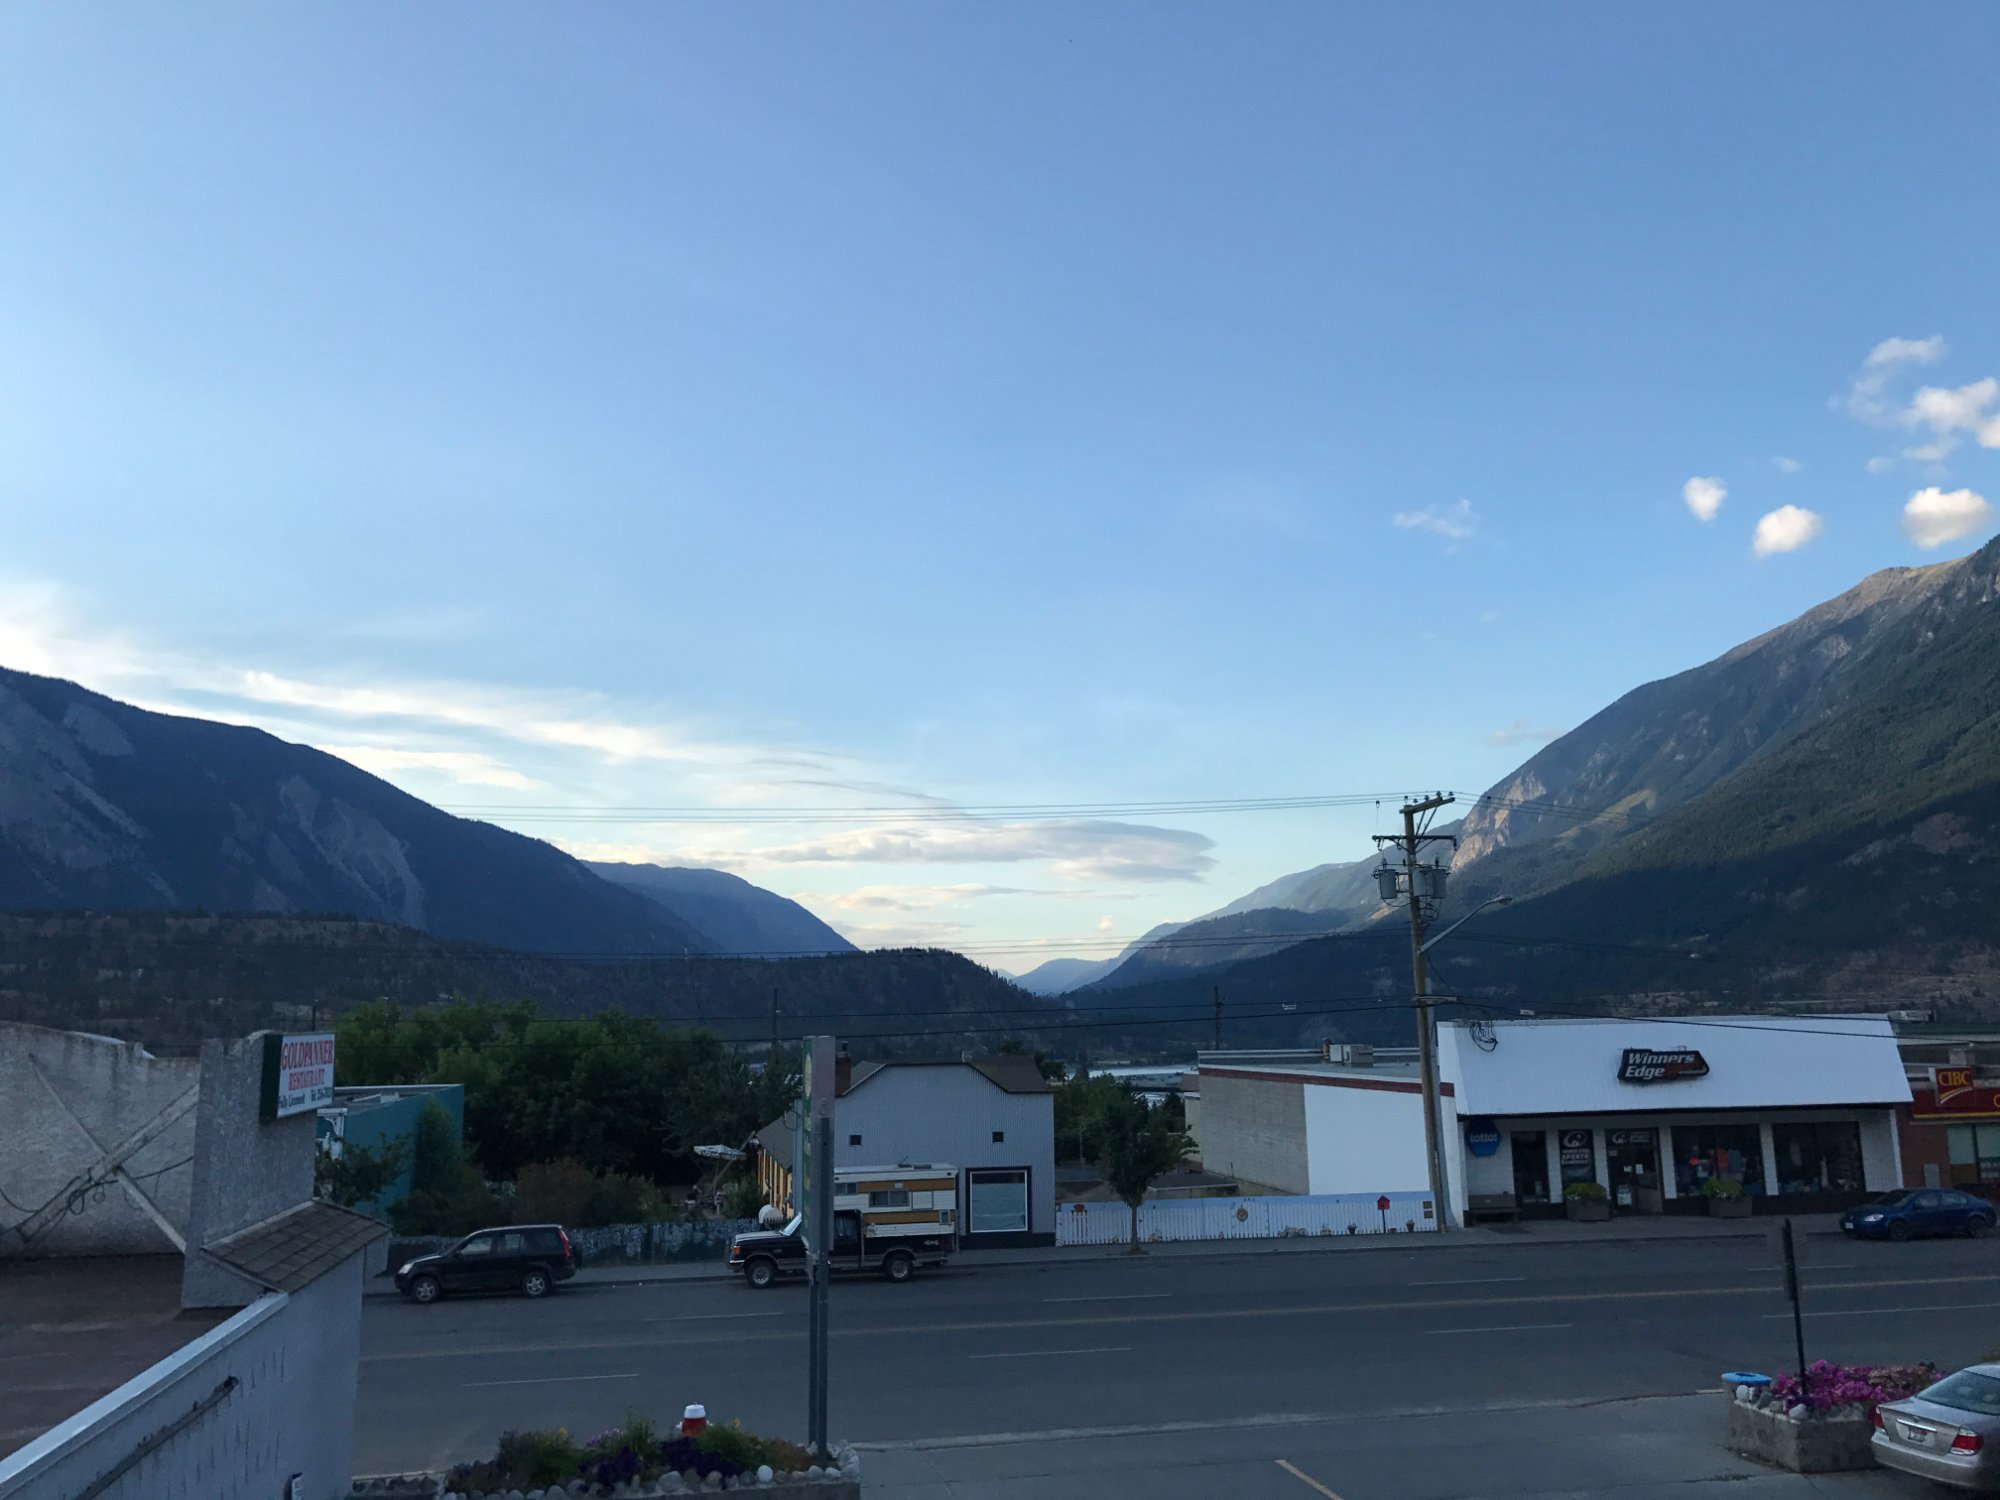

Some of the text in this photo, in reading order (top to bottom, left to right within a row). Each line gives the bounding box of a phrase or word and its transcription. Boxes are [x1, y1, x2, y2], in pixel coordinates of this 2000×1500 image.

[281, 1040, 333, 1071] GOLDPANNER
[1628, 1052, 1695, 1065] Winners
[288, 1068, 325, 1091] RESTAURANT
[1625, 1065, 1665, 1080] Edge
[1939, 1071, 1970, 1086] CIBC
